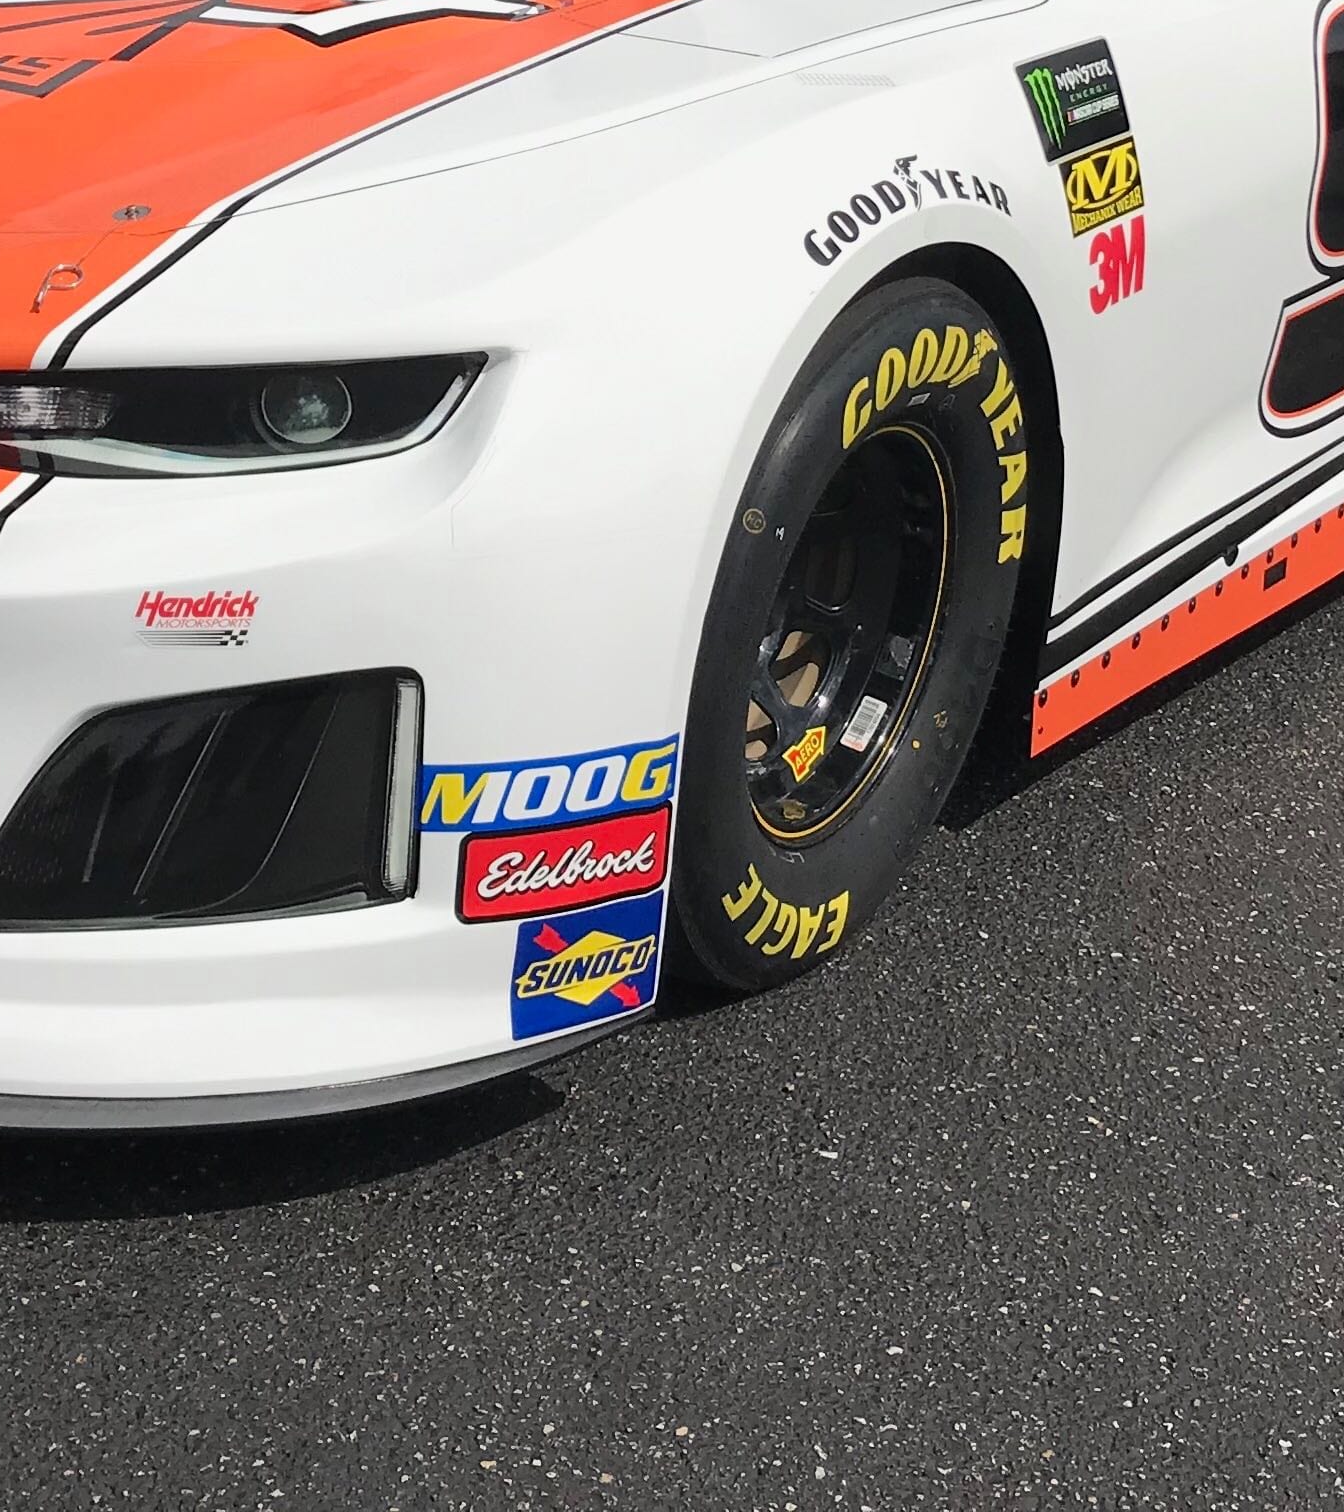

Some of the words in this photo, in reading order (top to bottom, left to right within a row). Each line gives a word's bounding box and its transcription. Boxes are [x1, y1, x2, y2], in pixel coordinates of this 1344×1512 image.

[1072, 205, 1118, 235] MECHANIX
[1115, 185, 1144, 215] WEAR
[1089, 214, 1146, 315] 3M
[842, 325, 1029, 565] GOODYEAR
[135, 590, 260, 627] Hendrick
[156, 618, 253, 629] MOTORSPORTS
[794, 733, 821, 769] AERO
[421, 743, 676, 825] MOOG
[477, 831, 656, 899] Edelbrock
[721, 862, 850, 960] EAGLE
[522, 941, 651, 994] SUNOCO
